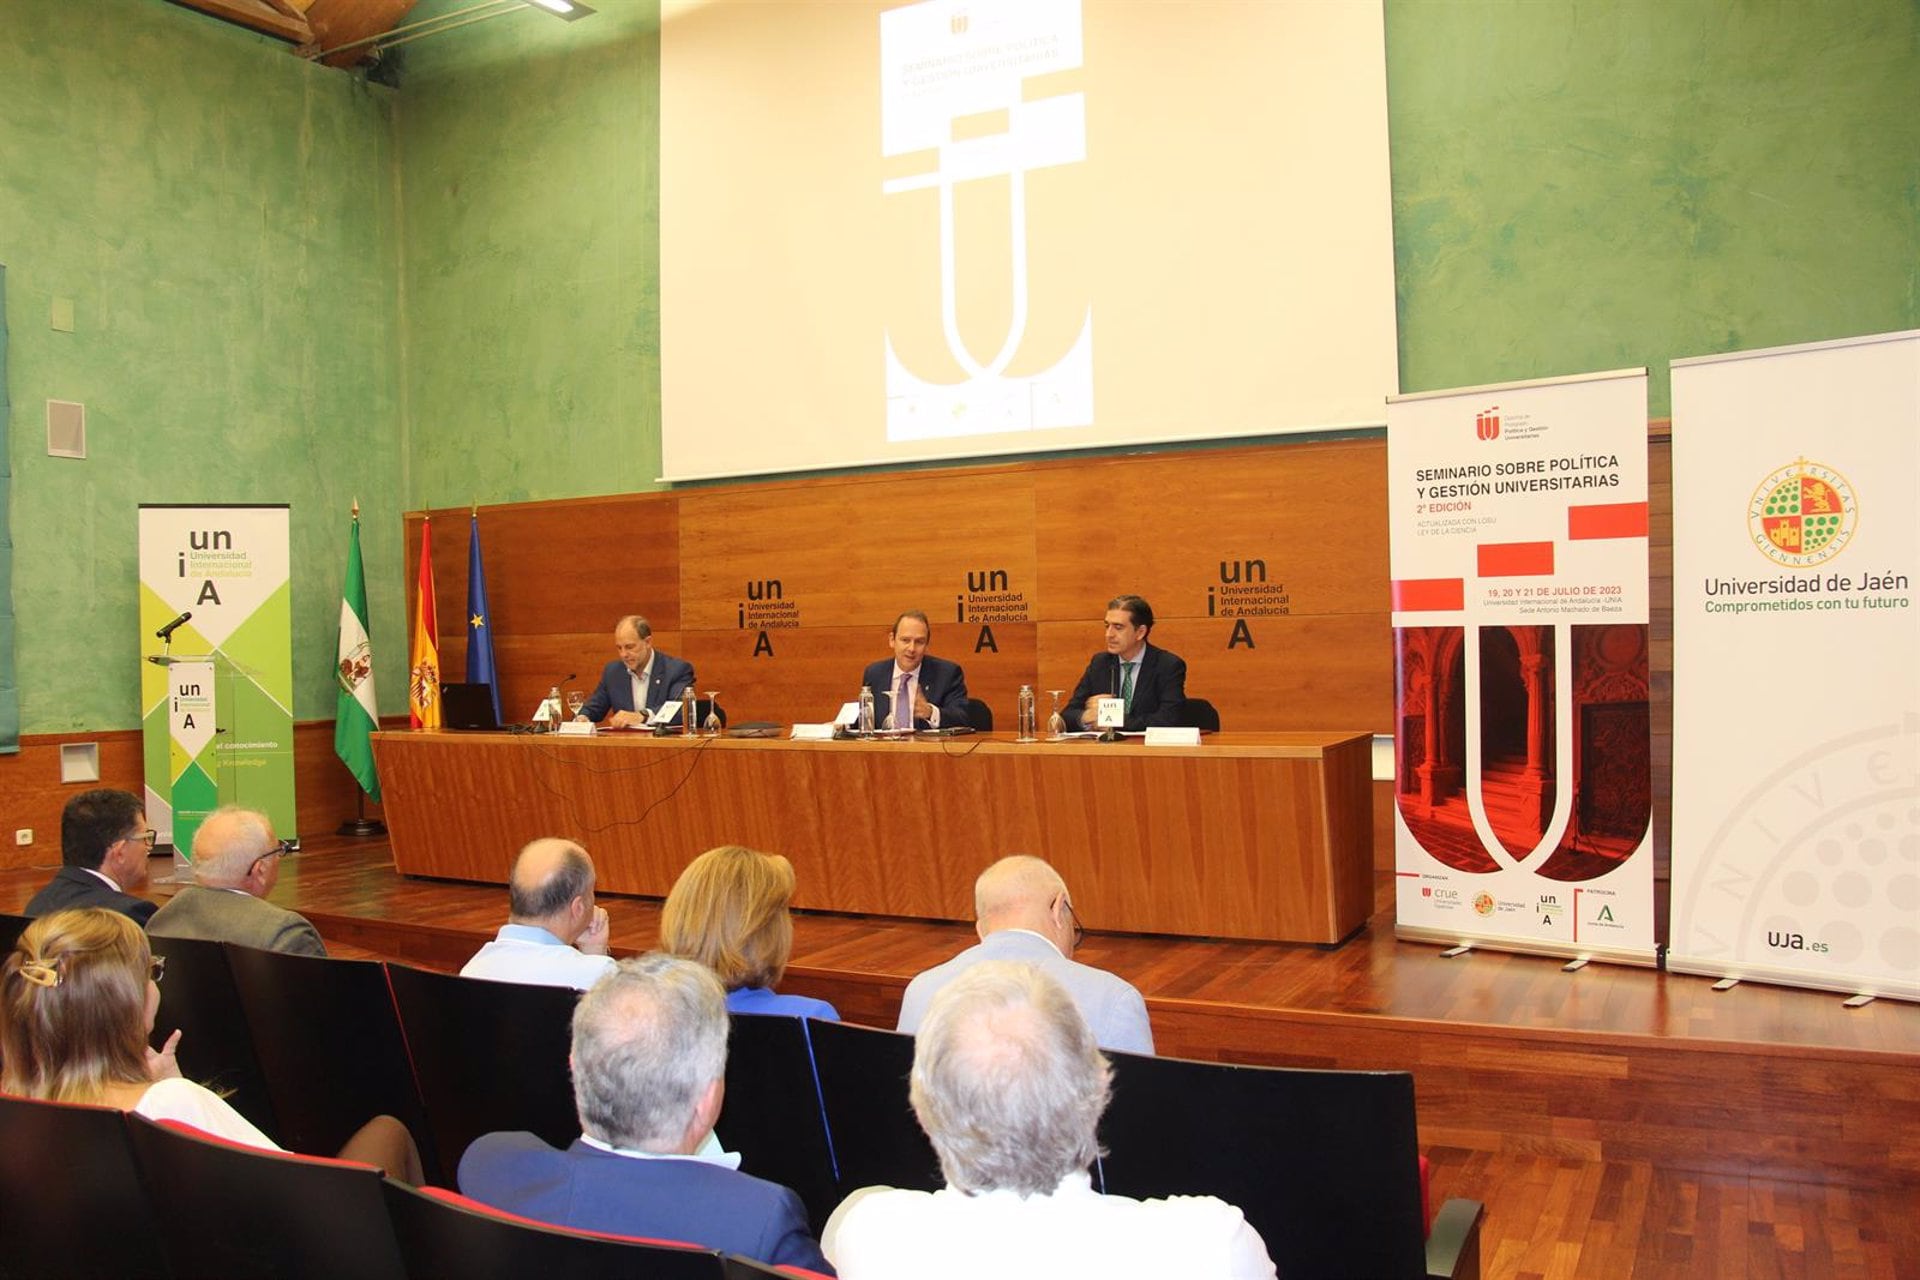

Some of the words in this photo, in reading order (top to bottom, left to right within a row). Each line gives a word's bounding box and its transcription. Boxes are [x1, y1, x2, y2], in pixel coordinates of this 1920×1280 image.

[1416, 464, 1492, 481] SEMINARIO
[1496, 460, 1545, 475] SOBRE
[1550, 454, 1619, 471] POLÍTICA
[1417, 487, 1425, 499] Y
[1429, 480, 1490, 498] GESTIÓN
[1495, 473, 1619, 494] UNIVERSITARIAS
[1429, 501, 1472, 513] EDICIÓN
[1462, 517, 1477, 525] CON
[190, 552, 246, 560] Universidad
[190, 561, 252, 569] Internacional
[1705, 575, 1820, 595] Universidad
[1827, 573, 1851, 592] de
[1857, 570, 1908, 591] Jaén
[1220, 584, 1284, 595] Universidad
[1488, 589, 1500, 598] 19,
[1503, 589, 1513, 597] 20
[1515, 588, 1522, 597] Y
[1524, 588, 1533, 597] 21
[1537, 587, 1549, 596] DE
[1552, 586, 1580, 596] JULIO
[1583, 586, 1596, 595] DE
[1599, 585, 1622, 595] 2023
[968, 593, 1023, 603] Universidad
[1220, 595, 1290, 606] Internacional
[1520, 597, 1558, 605] Internacional
[748, 601, 795, 611] Universidad
[968, 602, 1028, 613] Internacional
[1220, 607, 1234, 616] de
[1236, 605, 1290, 616] Andalucía
[1519, 606, 1535, 614] Sede
[1561, 605, 1590, 613] Machado
[1705, 598, 1813, 614] Comprometidos
[1817, 599, 1841, 610] con
[1845, 597, 1859, 609] tu
[1863, 596, 1909, 609] futuro
[748, 610, 799, 620] Internacional
[968, 613, 980, 623] de
[982, 612, 1028, 623] Andalucía
[748, 620, 758, 629] de
[760, 619, 799, 629] Andalucía
[224, 741, 278, 749] conocimiento
[1434, 888, 1458, 899] crue
